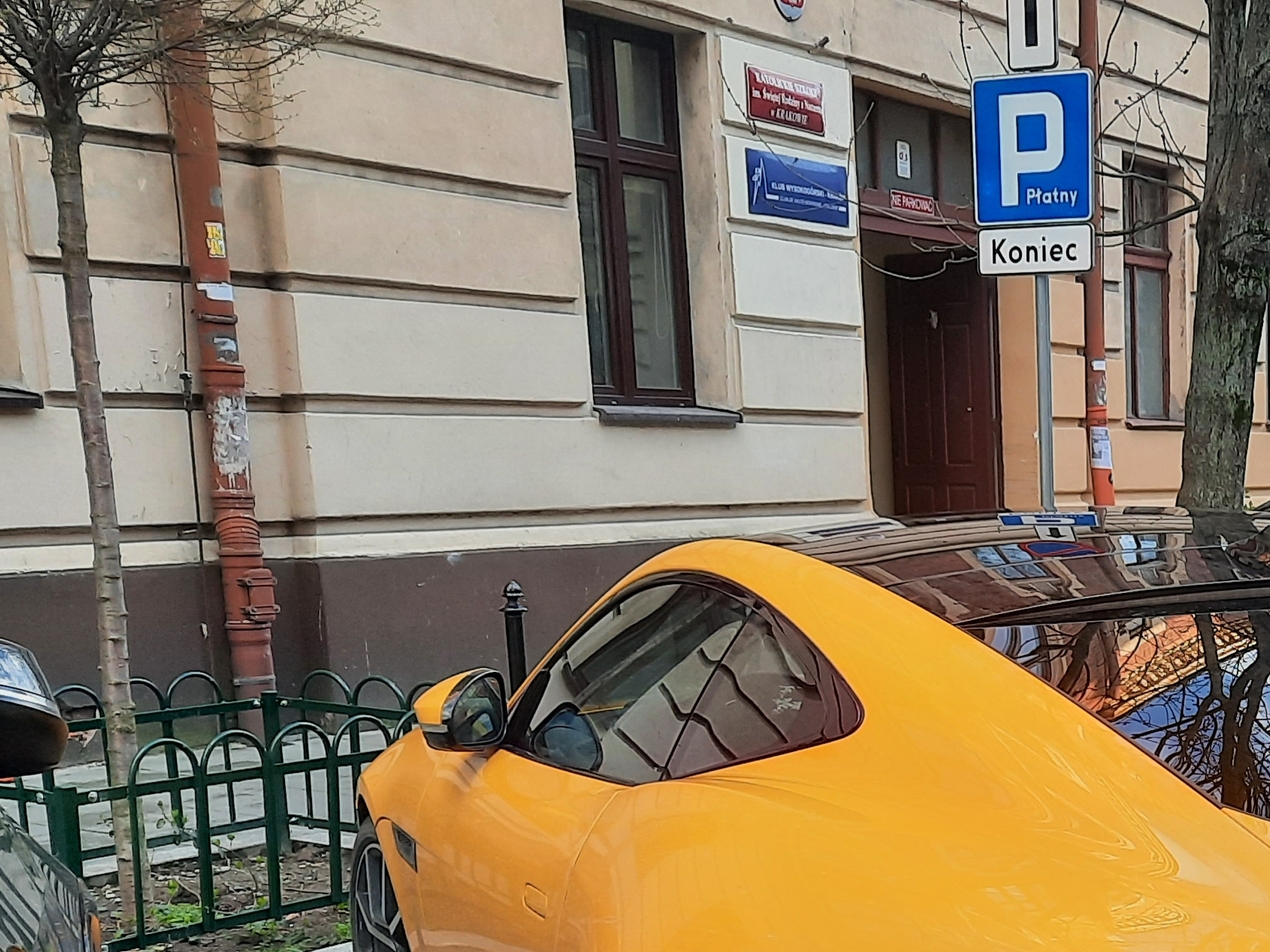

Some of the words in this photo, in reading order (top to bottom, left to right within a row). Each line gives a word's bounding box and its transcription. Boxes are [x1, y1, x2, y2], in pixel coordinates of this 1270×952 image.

[999, 92, 1064, 207] P
[1026, 187, 1078, 207] Płatny
[991, 236, 1077, 264] Koniec
